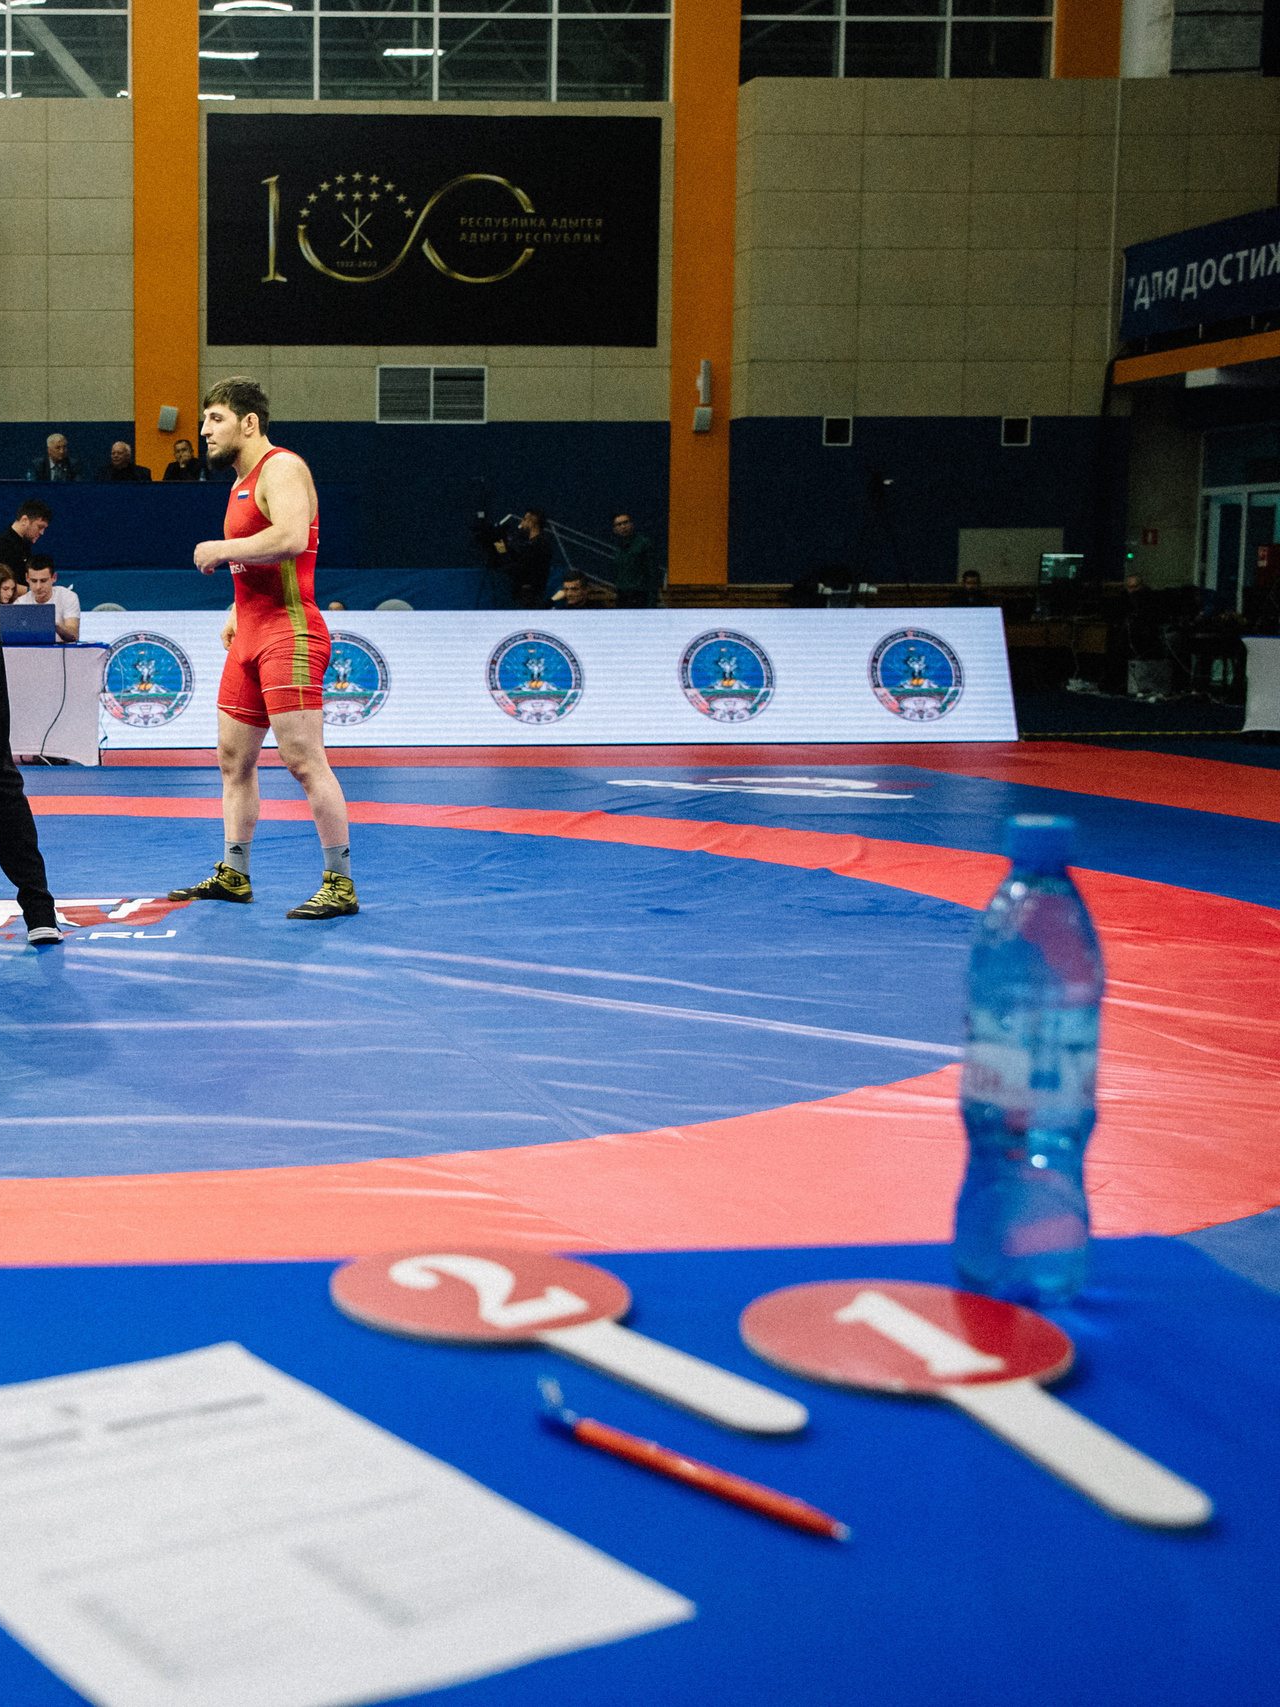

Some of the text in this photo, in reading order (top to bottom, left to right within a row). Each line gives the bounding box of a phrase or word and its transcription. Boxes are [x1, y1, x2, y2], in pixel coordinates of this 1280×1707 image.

[459, 217, 604, 229] РЕСПУБЛИКА АДЫГЕЯ
[389, 1253, 590, 1329] 2
[836, 1289, 1005, 1379] 1
